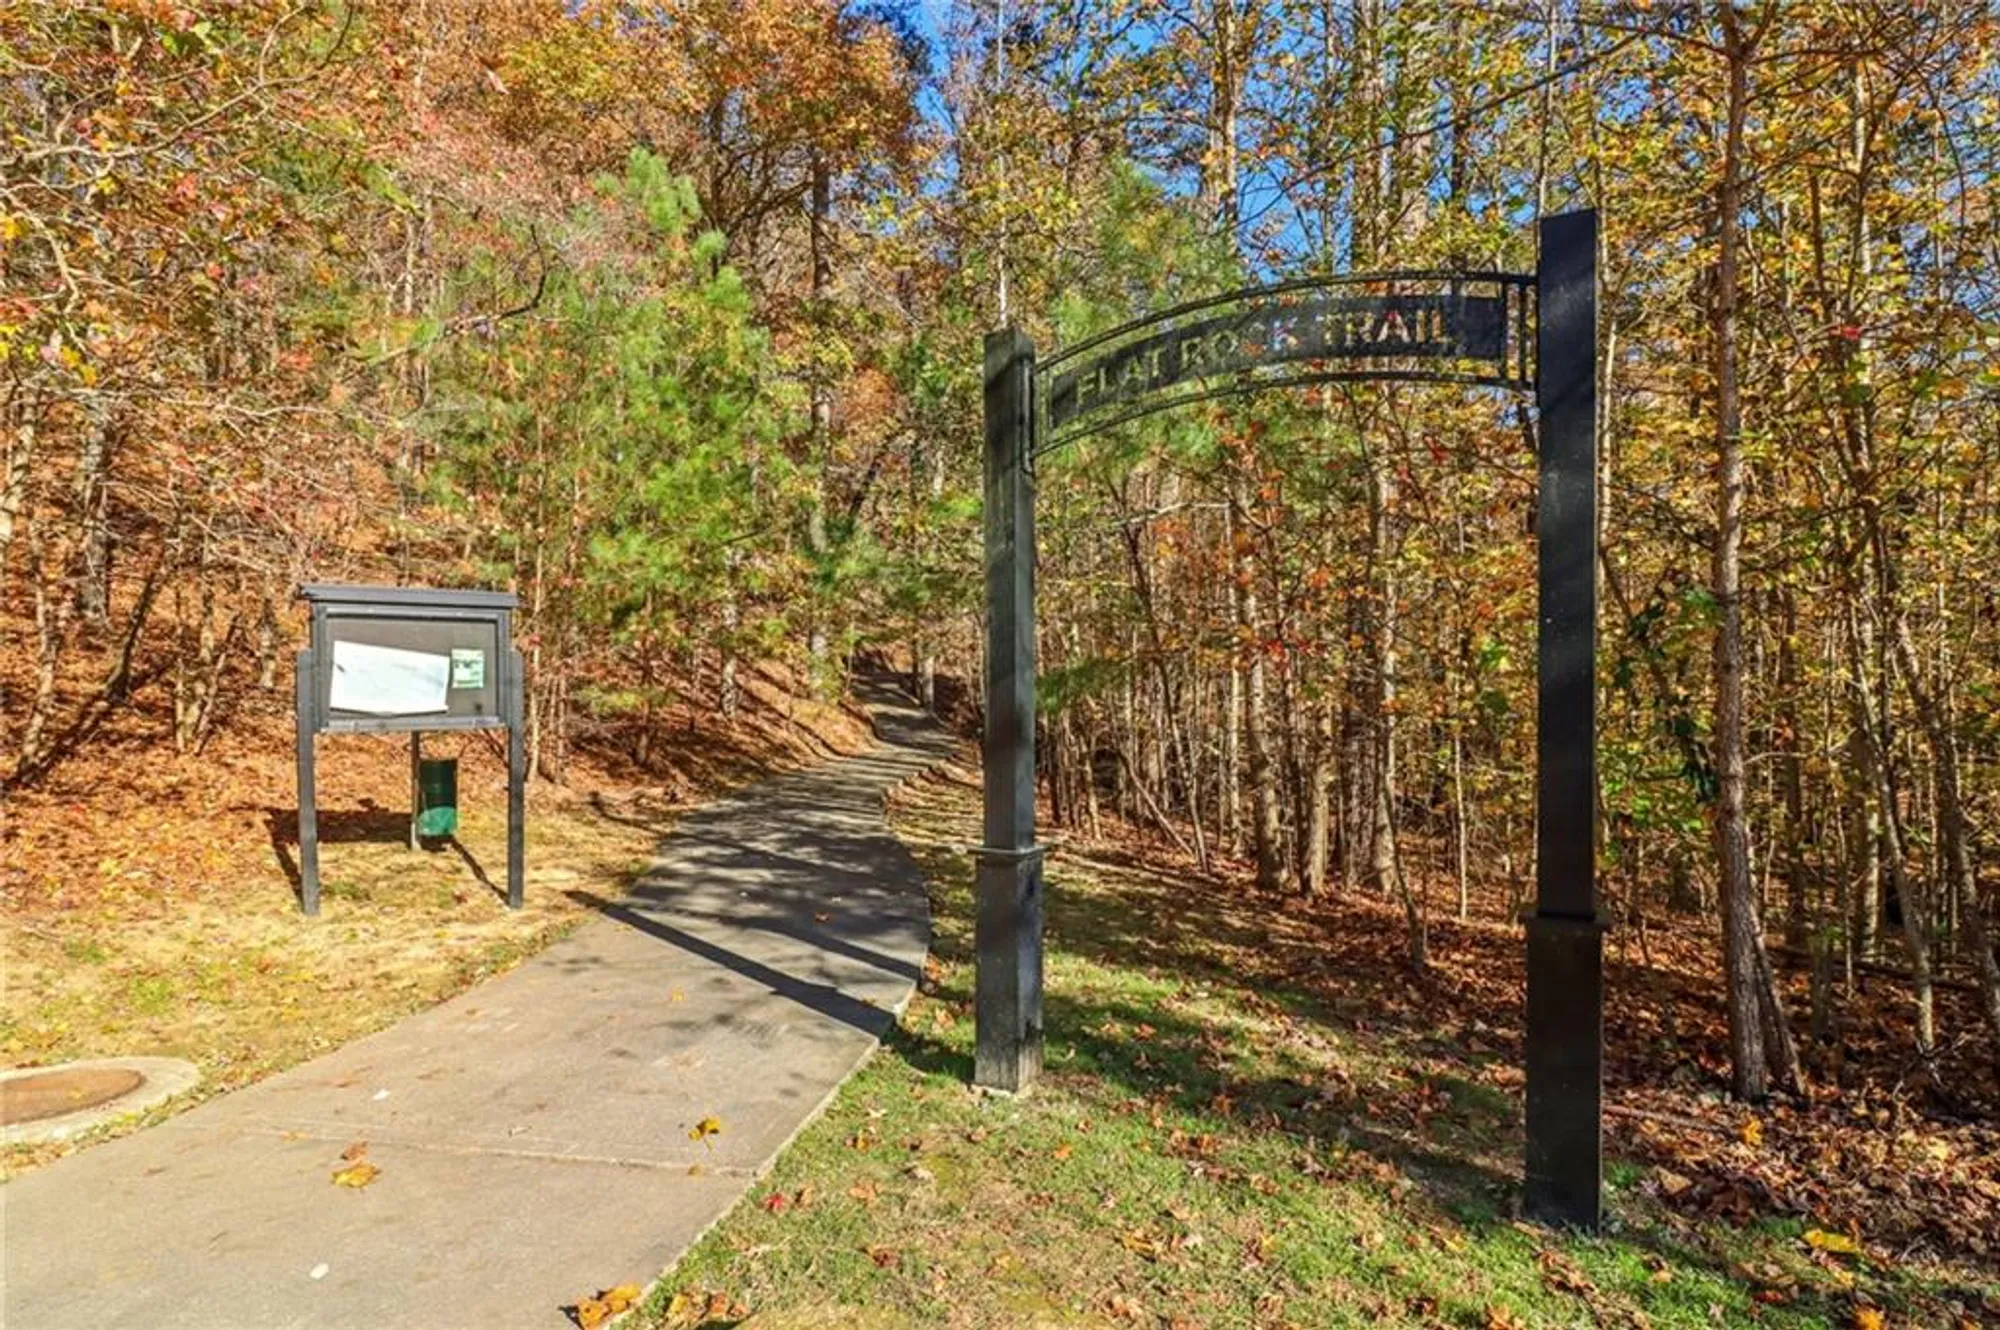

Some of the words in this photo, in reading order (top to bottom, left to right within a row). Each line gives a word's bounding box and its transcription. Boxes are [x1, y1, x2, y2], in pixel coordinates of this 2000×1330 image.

[1076, 344, 1167, 406] FLAT
[1180, 317, 1300, 368] ROCK
[1314, 309, 1453, 345] TRAIL
